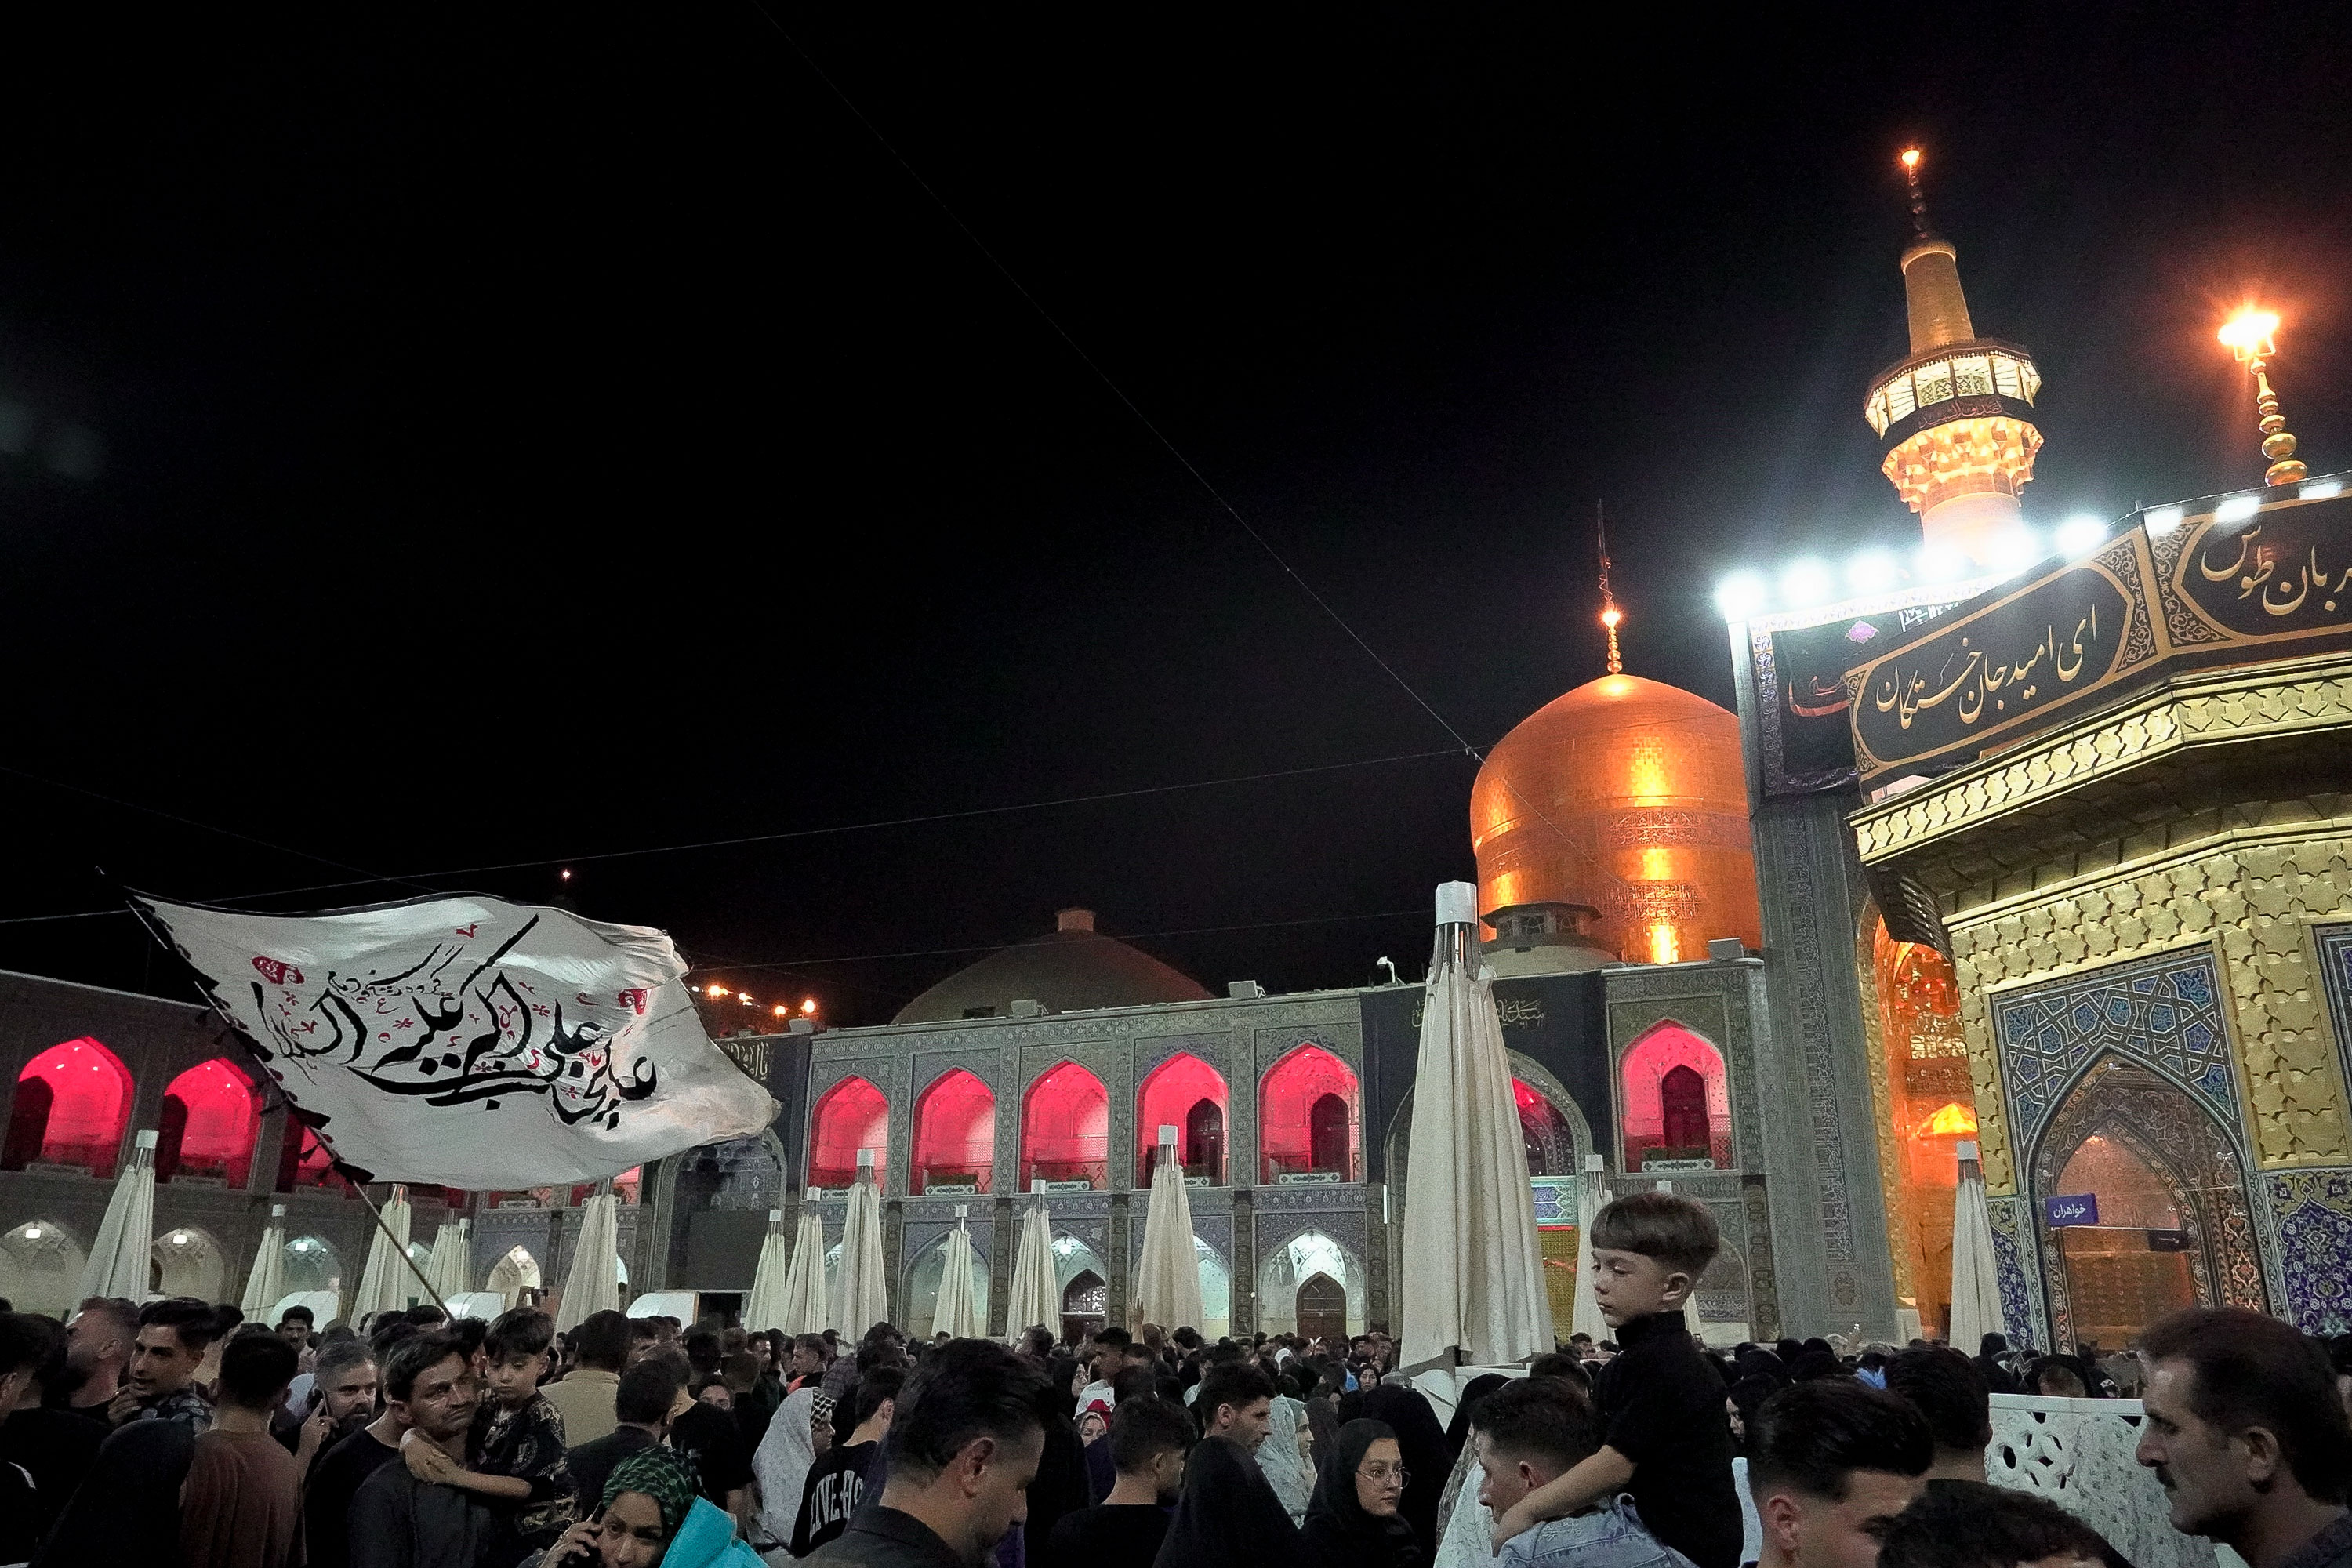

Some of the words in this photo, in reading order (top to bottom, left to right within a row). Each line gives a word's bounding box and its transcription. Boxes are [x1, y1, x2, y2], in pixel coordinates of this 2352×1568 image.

[2201, 525, 2274, 600] طوس
[2005, 624, 2054, 700] امید
[2057, 603, 2097, 682] ای
[1876, 637, 1983, 730] خستگان
[1959, 653, 2008, 724] جان
[2053, 1202, 2086, 1218] خواهران
